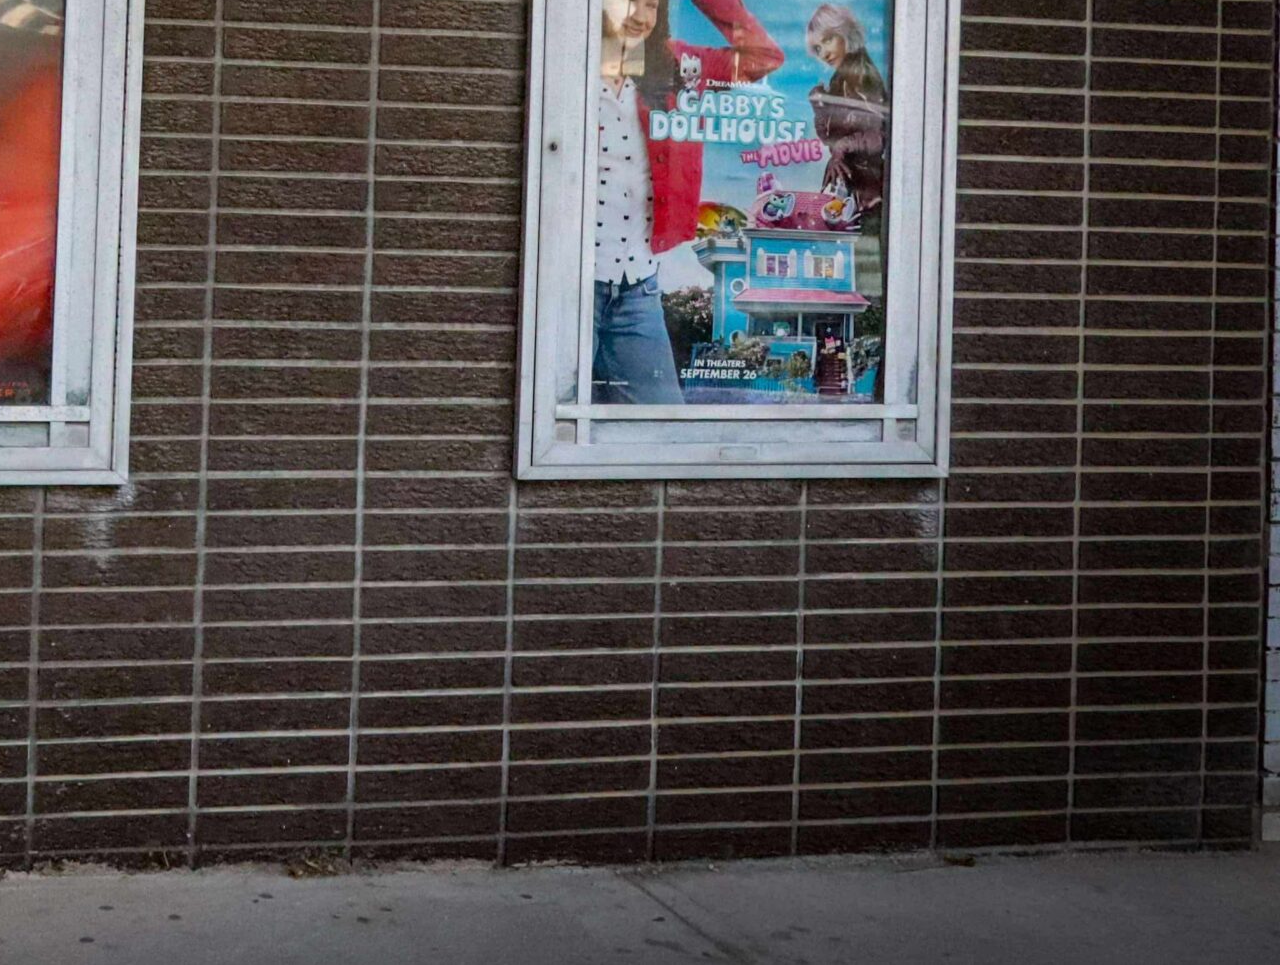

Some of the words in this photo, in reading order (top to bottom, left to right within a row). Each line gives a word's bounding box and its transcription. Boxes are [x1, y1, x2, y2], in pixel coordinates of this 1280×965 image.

[649, 110, 807, 144] DOLLHOUSE
[757, 139, 823, 168] MOVIE
[694, 359, 704, 367] IN
[706, 359, 746, 368] THEATERS
[680, 369, 740, 379] SEPTEMBER
[742, 369, 758, 379] 26
